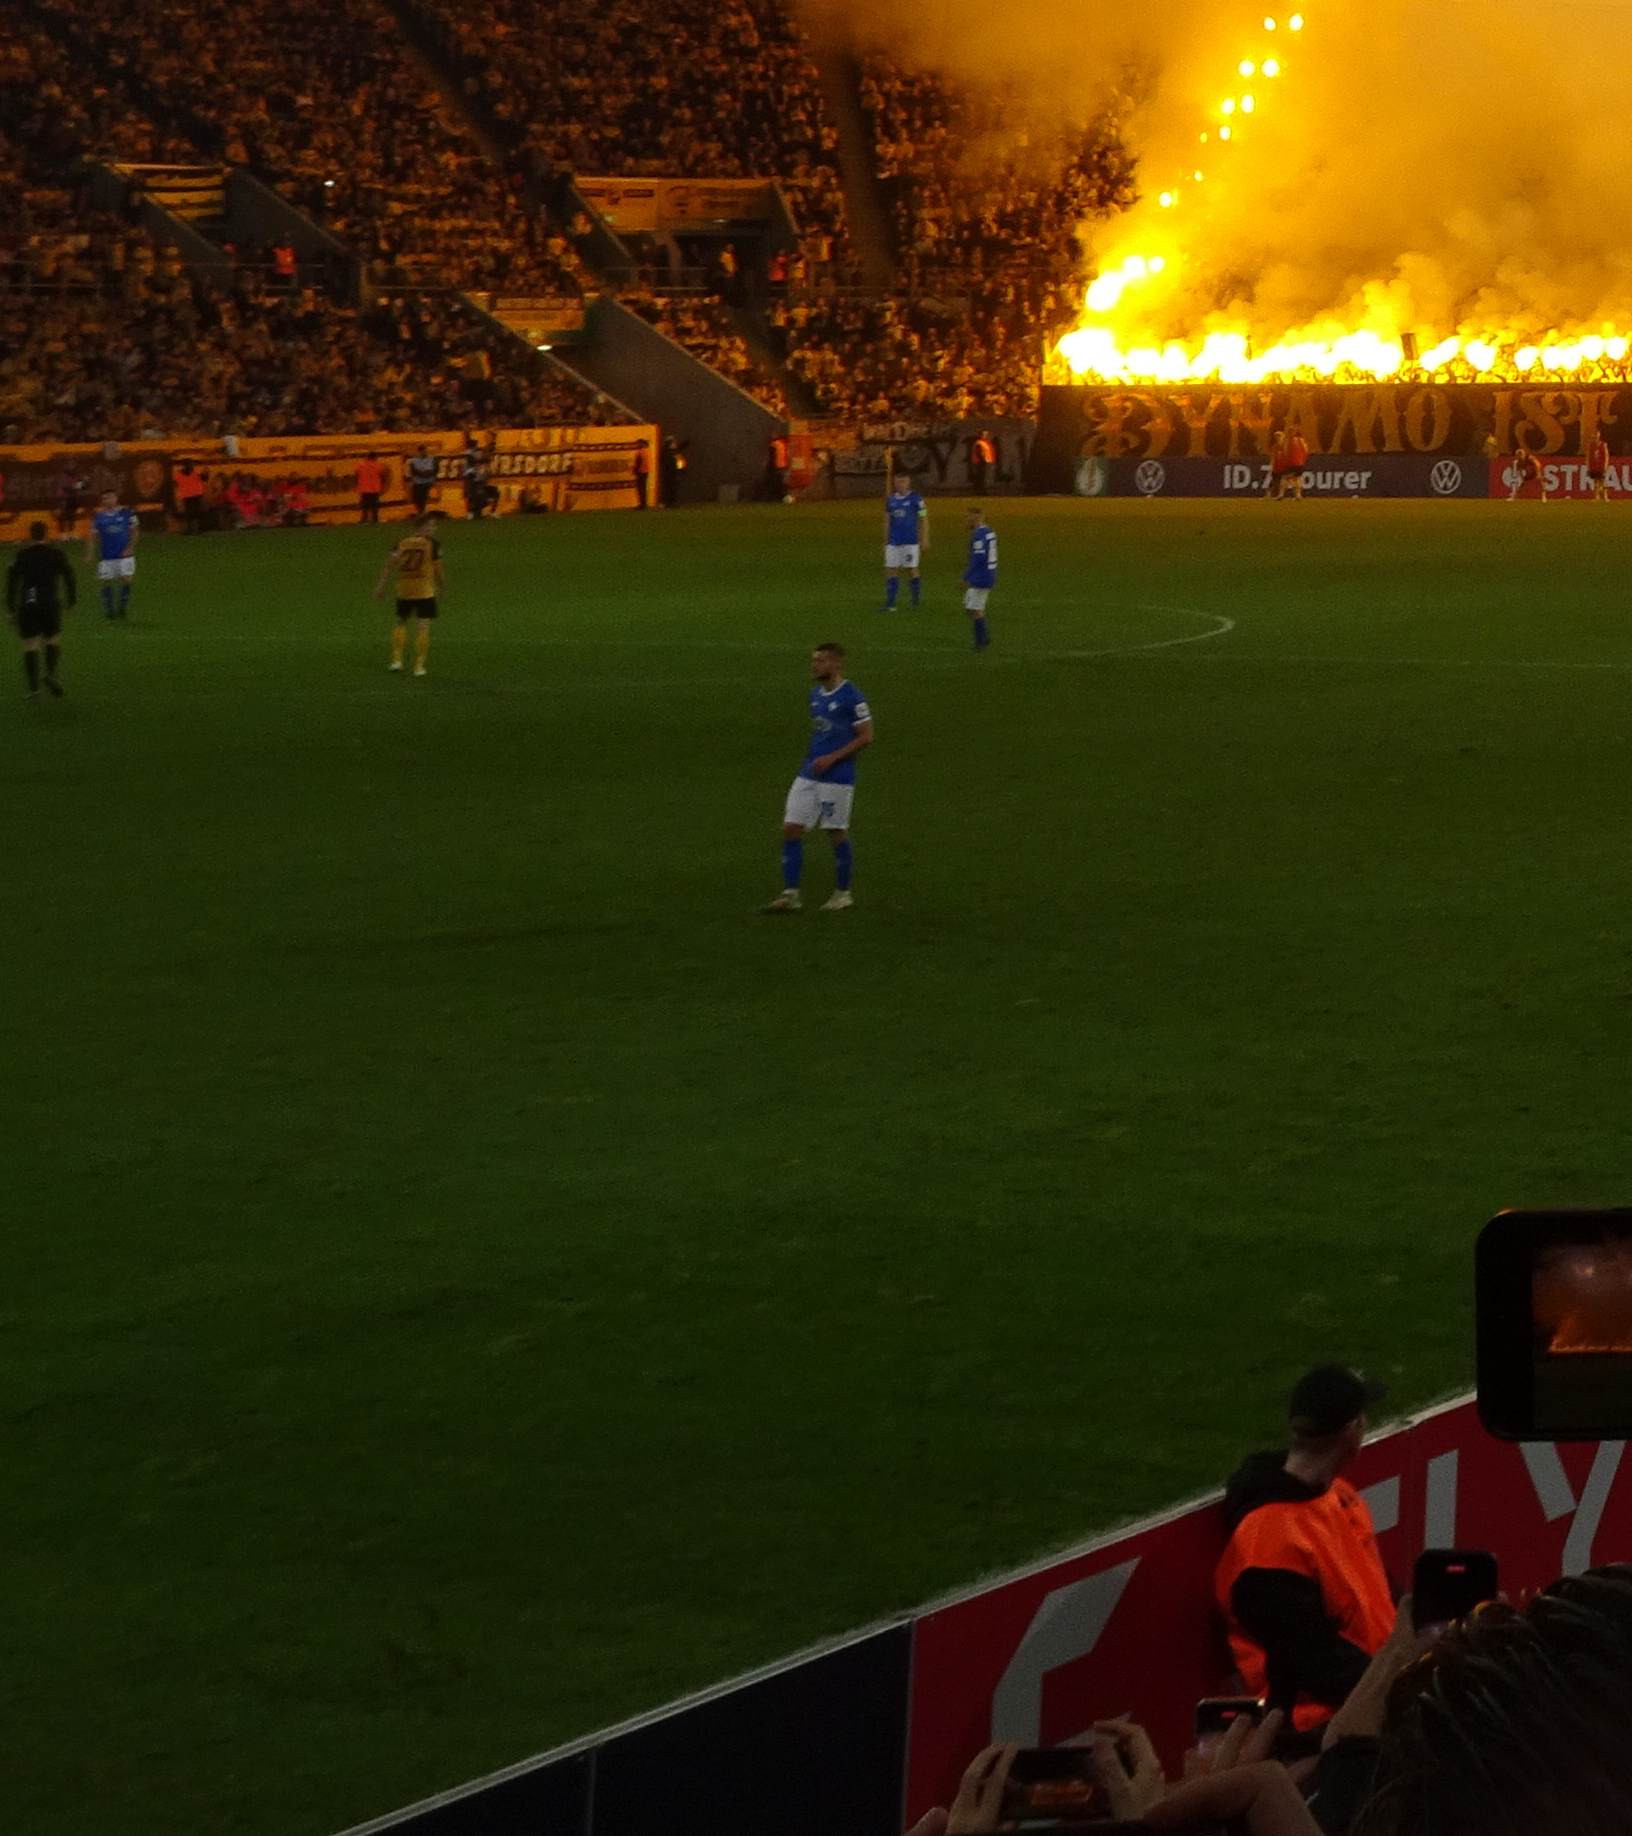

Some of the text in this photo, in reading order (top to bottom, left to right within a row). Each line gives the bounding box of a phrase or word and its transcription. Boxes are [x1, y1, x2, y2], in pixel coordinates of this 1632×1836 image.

[1492, 390, 1617, 456] IST
[1223, 465, 1373, 490] ID.7 ourer
